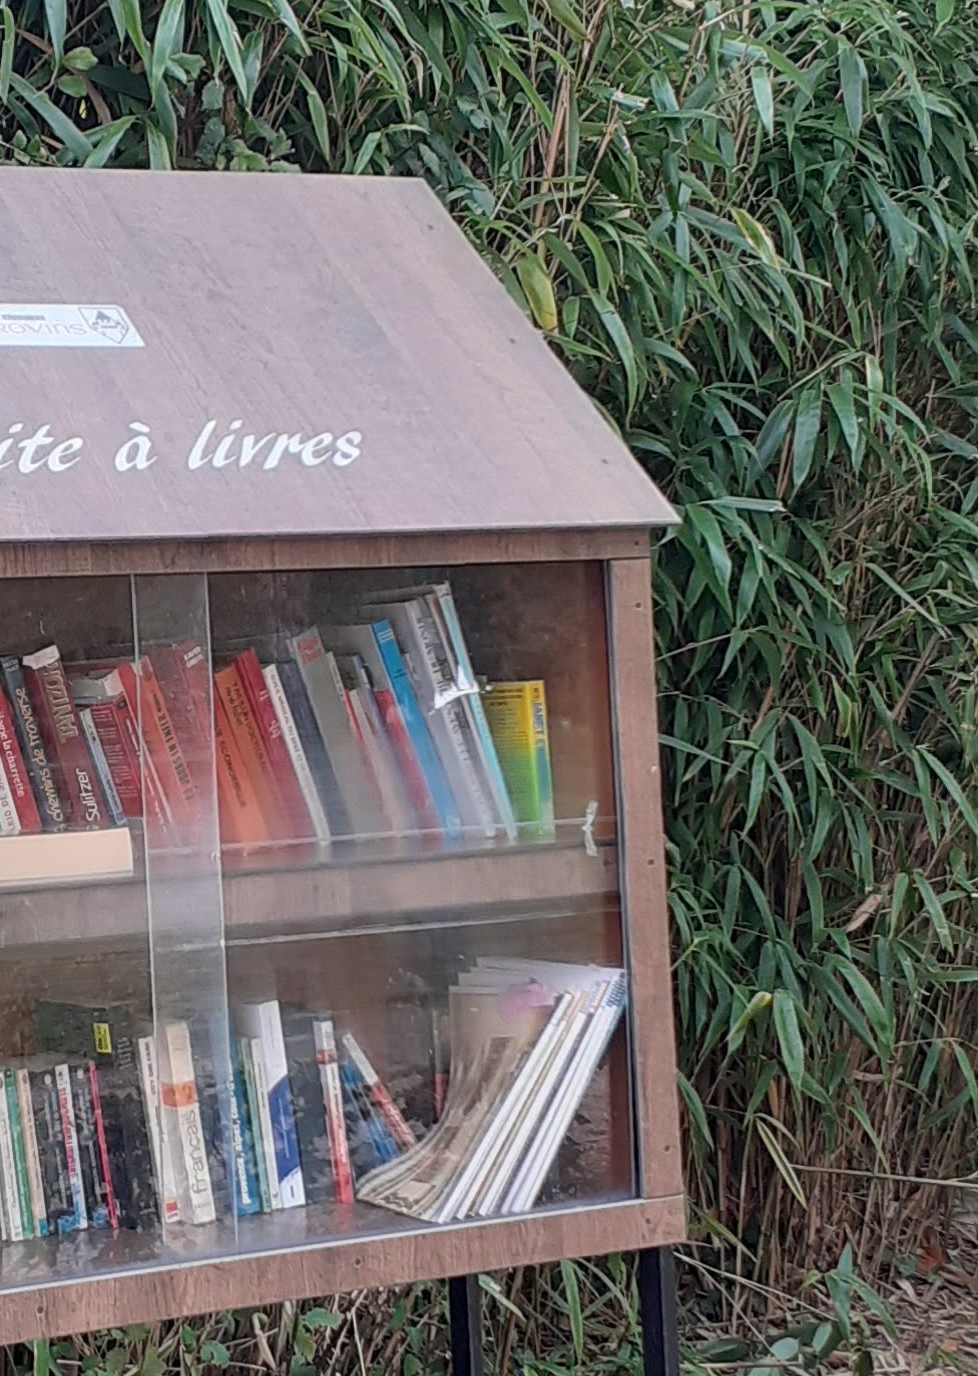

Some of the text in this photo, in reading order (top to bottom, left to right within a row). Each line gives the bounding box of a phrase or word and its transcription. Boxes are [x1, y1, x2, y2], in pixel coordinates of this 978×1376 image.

[114, 421, 160, 472] à
[186, 418, 364, 470] livres
[33, 748, 47, 766] de
[76, 767, 100, 822] Sulitzer
